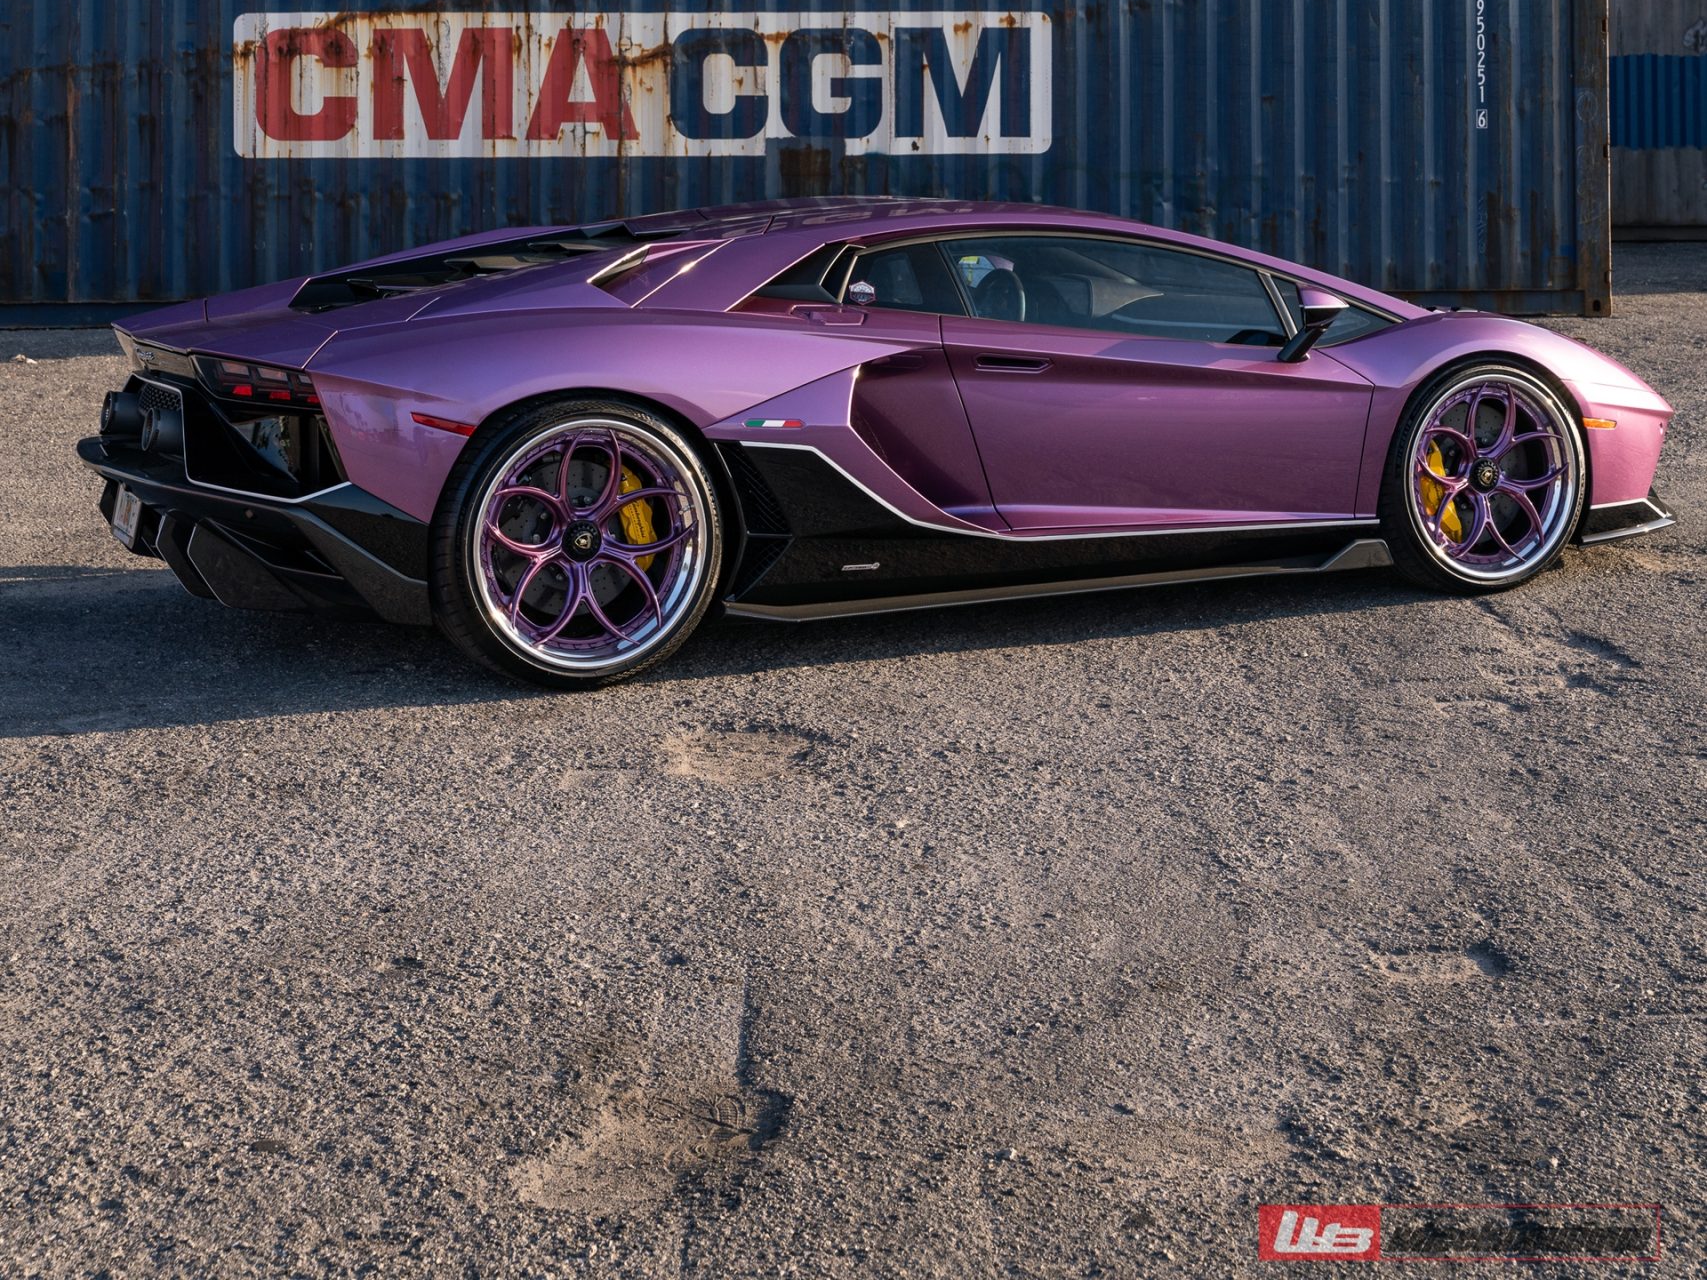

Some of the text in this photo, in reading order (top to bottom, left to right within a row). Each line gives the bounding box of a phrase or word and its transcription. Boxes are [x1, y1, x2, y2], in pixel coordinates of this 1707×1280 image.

[255, 26, 1031, 142] CMA CGM
[1476, 0, 1486, 103] 950251
[1476, 109, 1488, 128] 6
